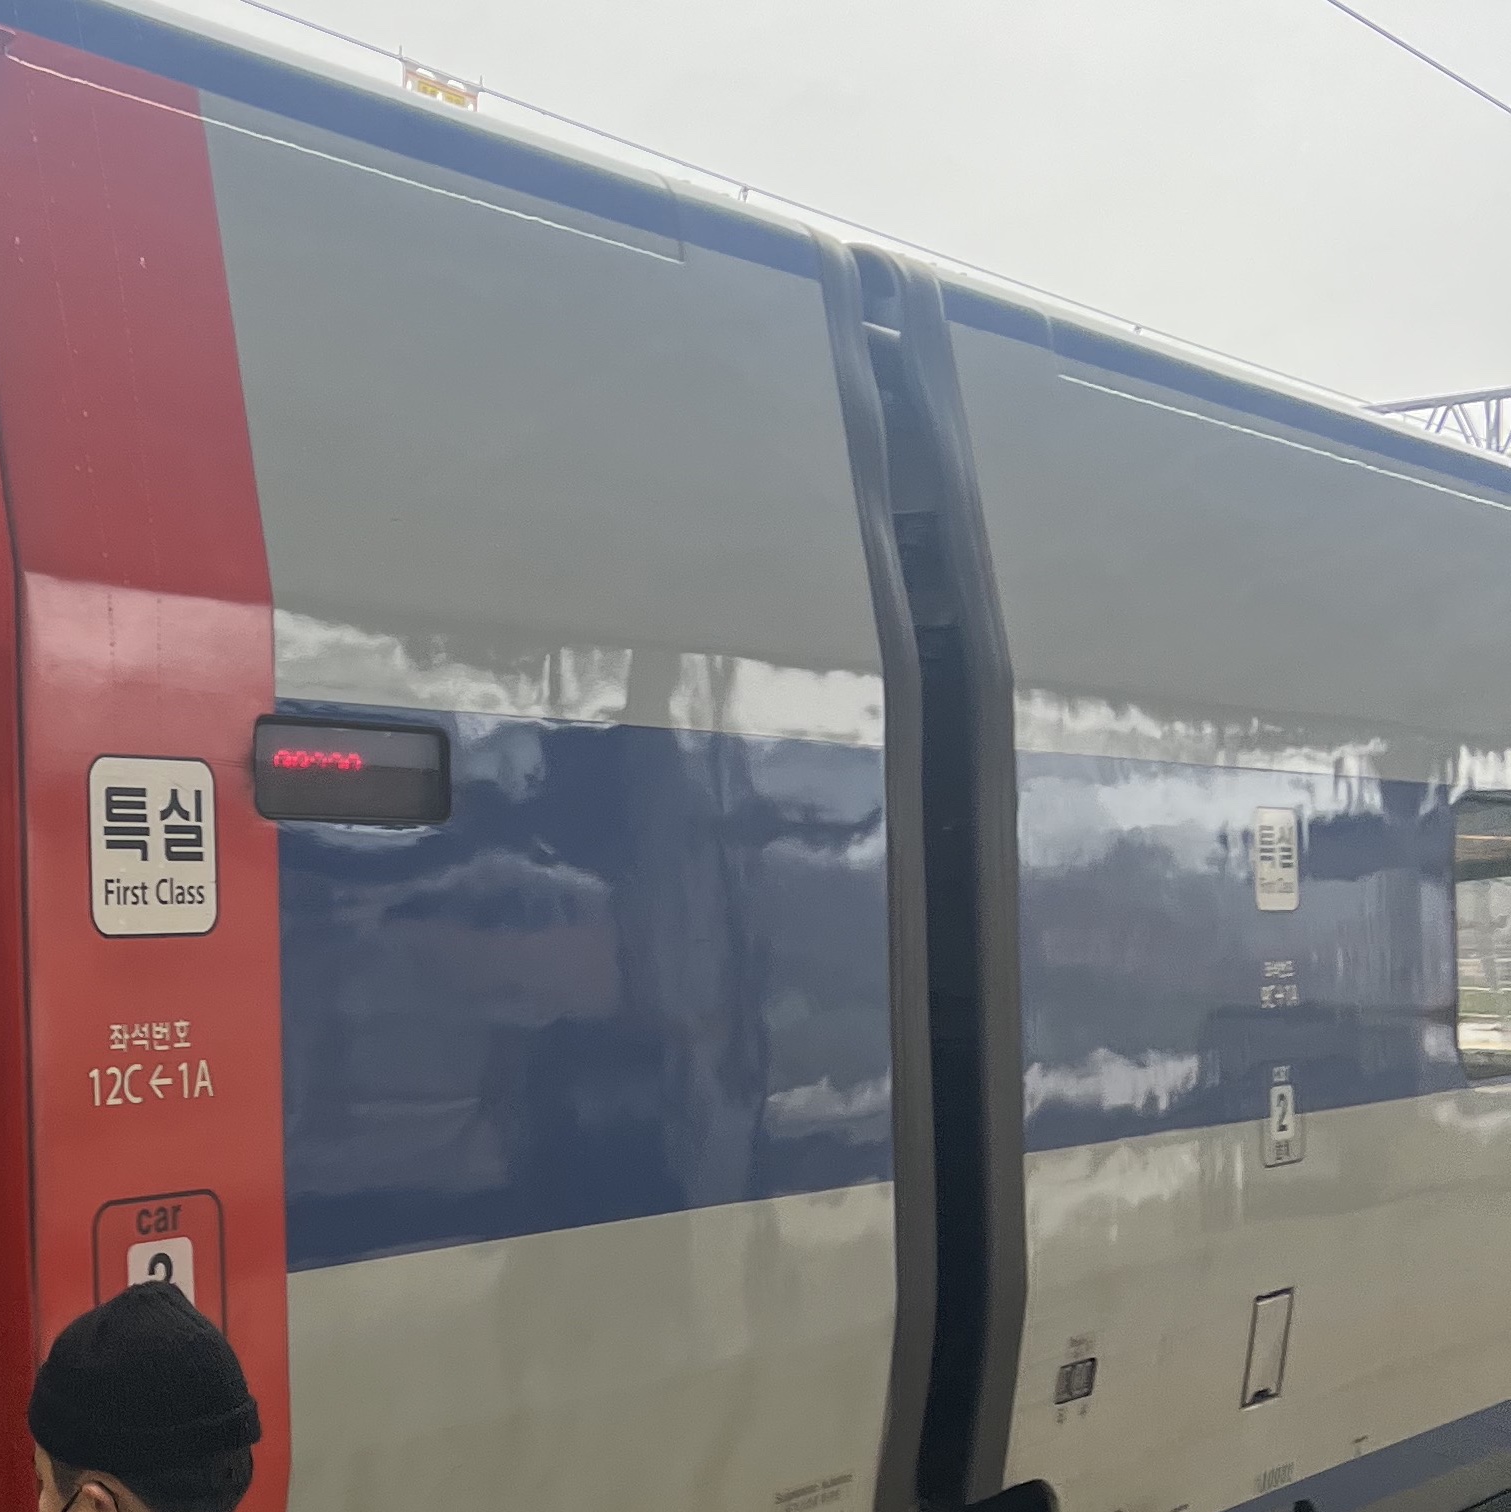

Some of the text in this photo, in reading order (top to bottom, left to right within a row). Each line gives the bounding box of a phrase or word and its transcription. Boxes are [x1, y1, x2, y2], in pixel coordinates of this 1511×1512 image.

[103, 786, 205, 862] 특실
[104, 877, 205, 906] First Class
[109, 1020, 191, 1052] 좌석번호
[1276, 1093, 1288, 1132] 2
[135, 1204, 182, 1236] car
